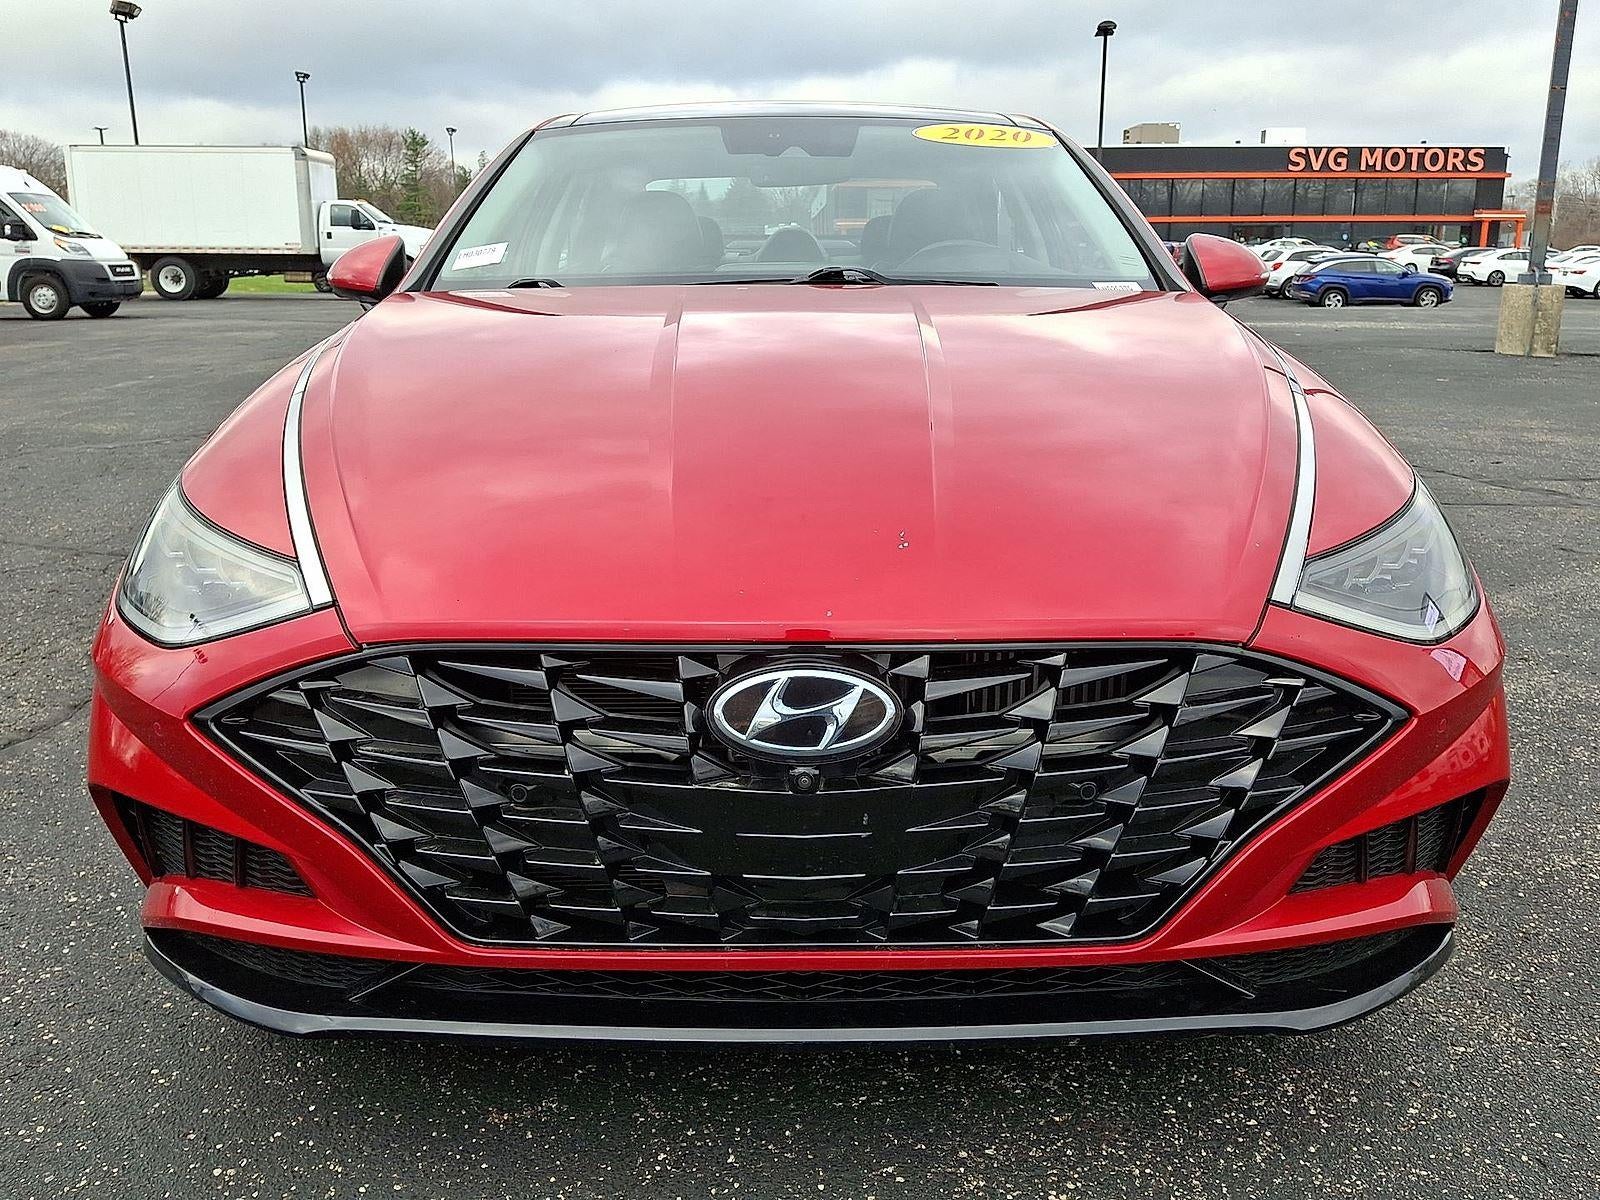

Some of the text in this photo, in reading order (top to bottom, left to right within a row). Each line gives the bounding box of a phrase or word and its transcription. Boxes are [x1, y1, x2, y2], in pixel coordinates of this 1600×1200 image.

[941, 127, 1032, 143] 2020
[1287, 147, 1486, 172] SVG MOTORS
